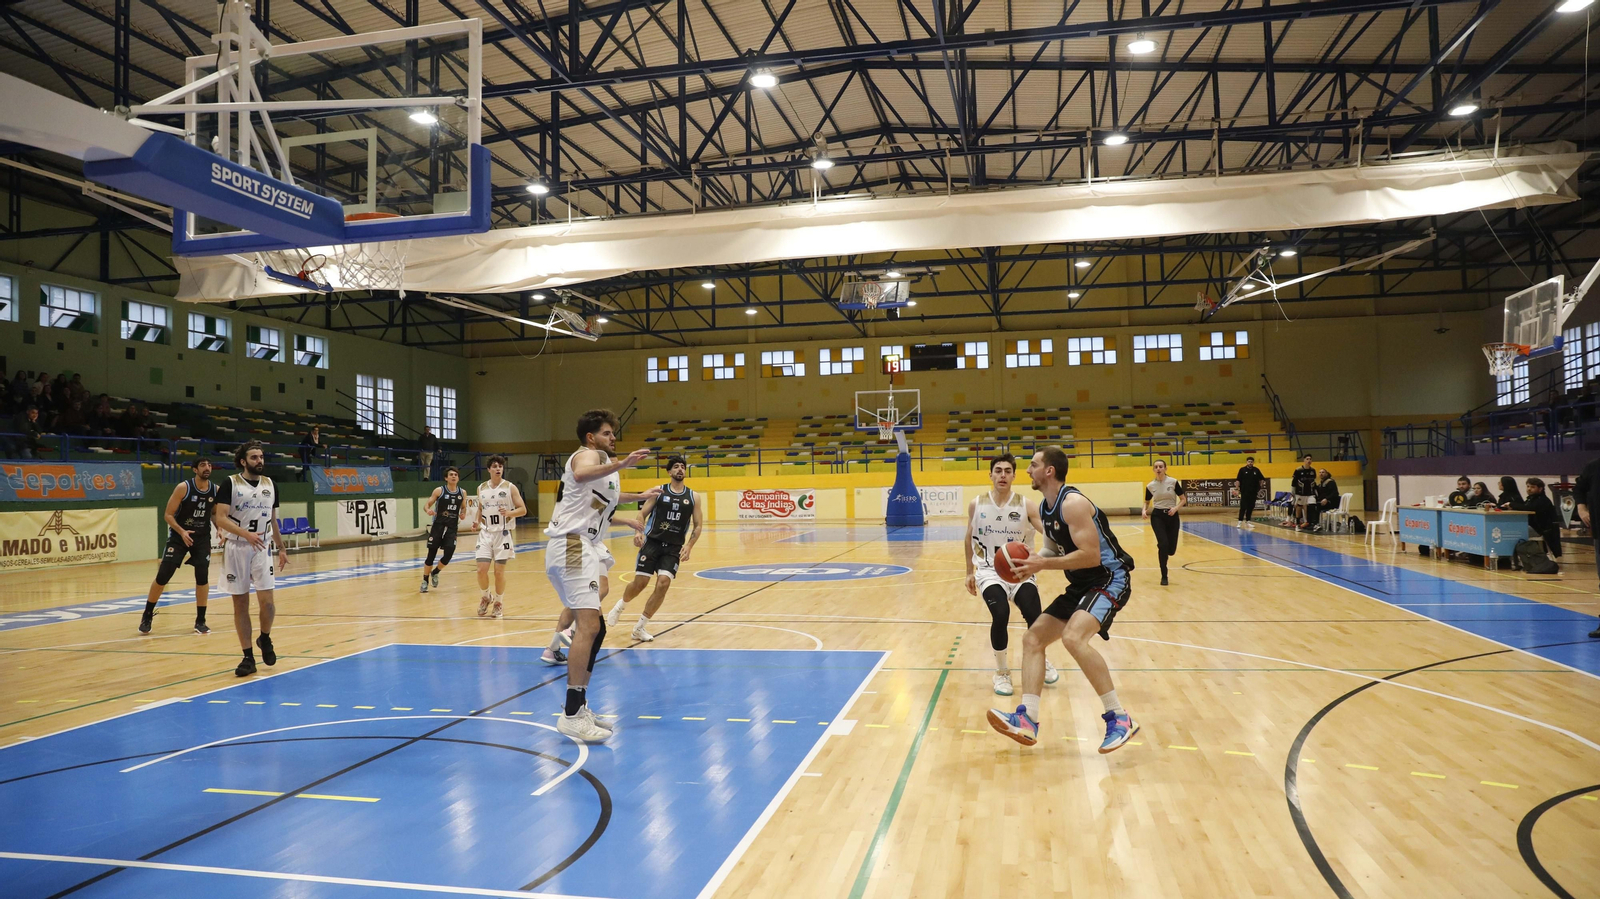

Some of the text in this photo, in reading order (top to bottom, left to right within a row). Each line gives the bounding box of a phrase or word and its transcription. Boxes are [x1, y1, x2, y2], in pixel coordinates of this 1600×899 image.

[211, 162, 315, 215] SPORT SYSTEM
[887, 361, 899, 373] 19
[7, 466, 117, 497] deportes
[326, 470, 380, 491] deportes
[740, 500, 751, 508] de
[752, 500, 765, 508] las
[346, 499, 388, 536] LA PILAR
[490, 514, 500, 525] 10
[666, 511, 681, 520] ULB
[248, 520, 258, 532] 9
[1404, 516, 1431, 530] deportes
[1448, 521, 1477, 537] deportes
[60, 539, 68, 552] e
[75, 532, 117, 552] HIJOS
[269, 566, 274, 575] 9
